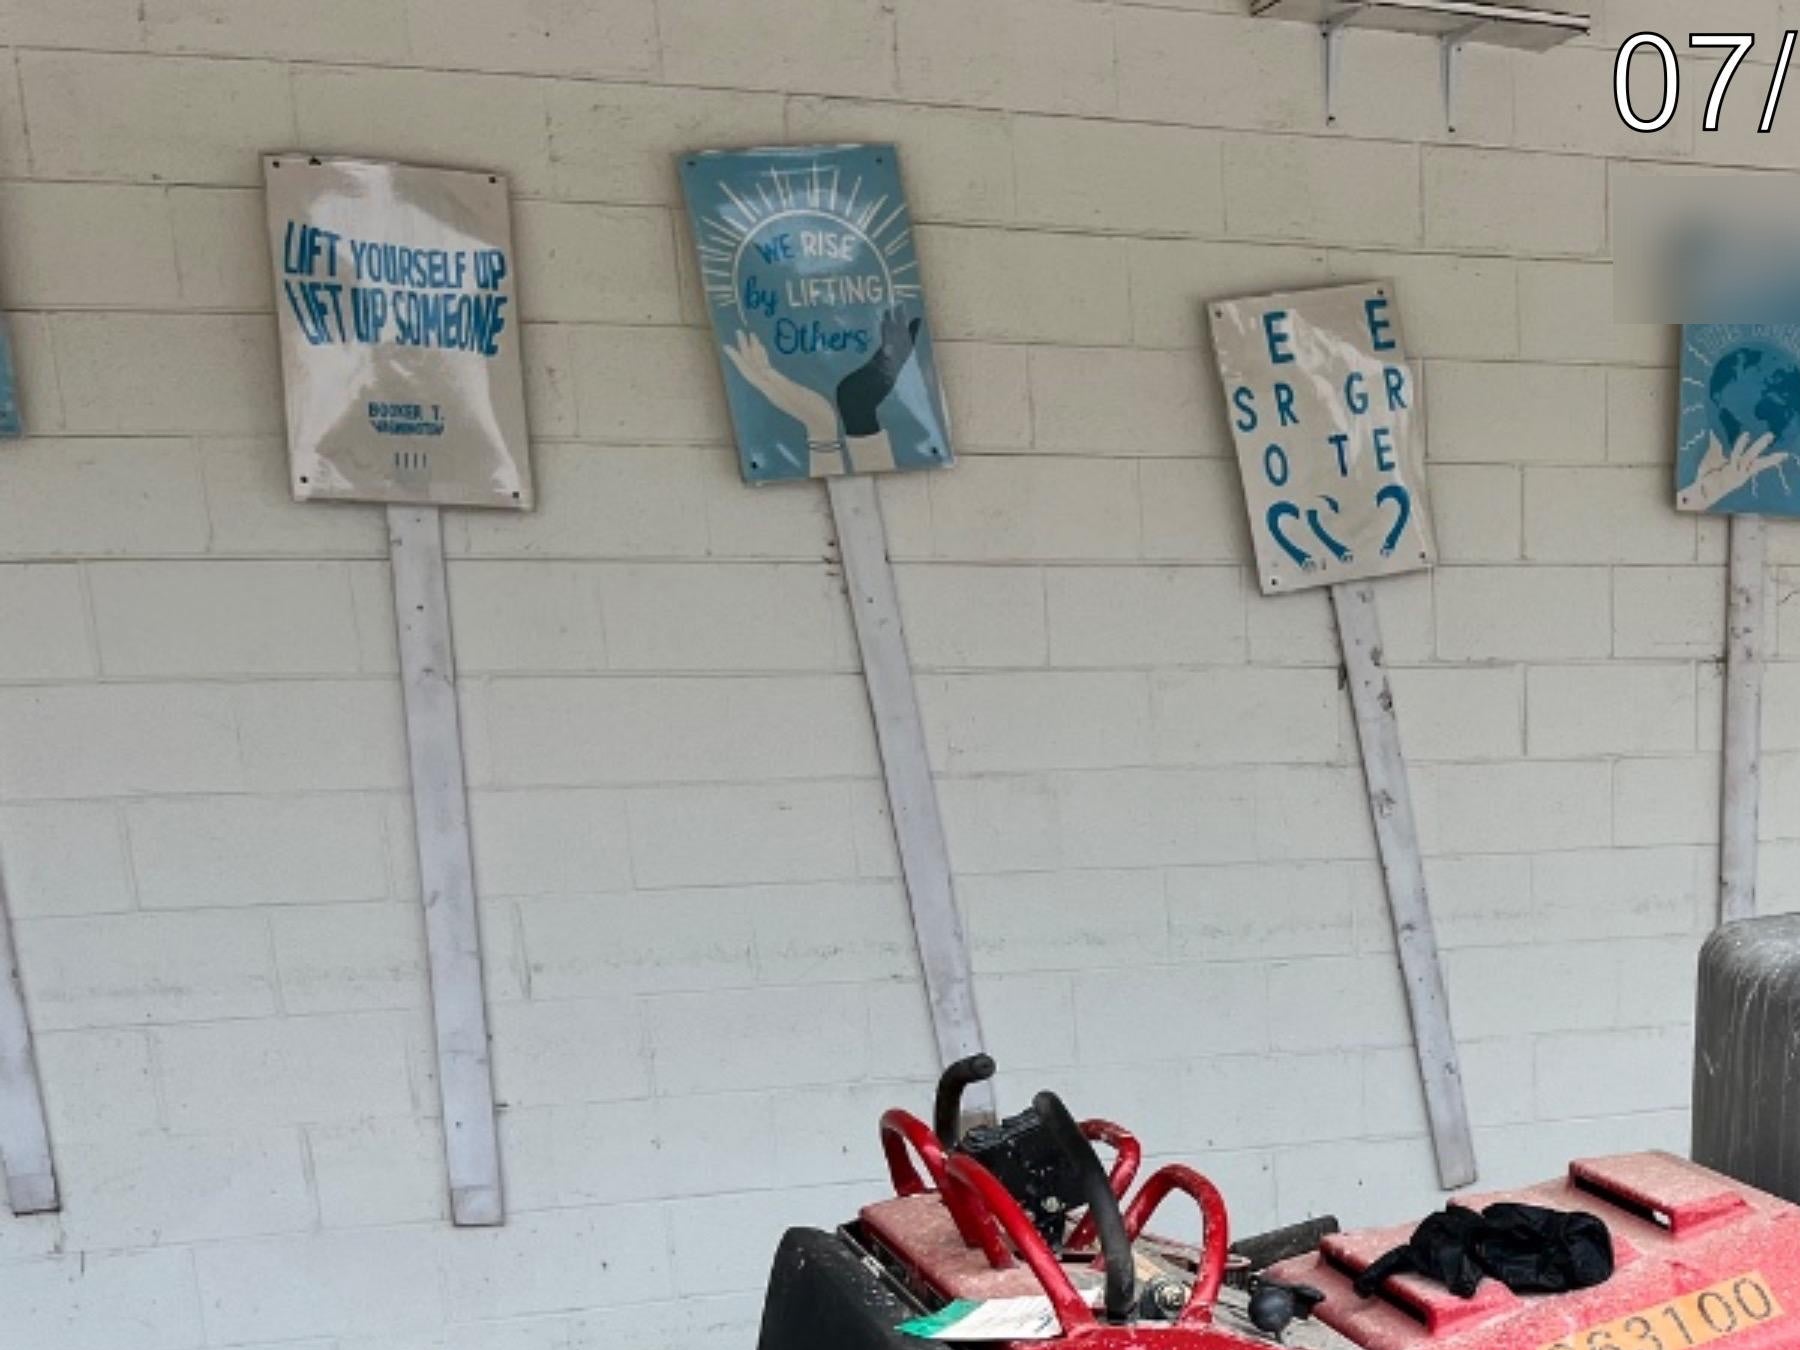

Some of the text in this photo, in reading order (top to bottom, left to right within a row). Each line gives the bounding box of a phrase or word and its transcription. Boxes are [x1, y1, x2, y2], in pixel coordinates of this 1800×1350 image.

[284, 221, 508, 291] LIFT YOURSELF UP
[754, 231, 857, 265] WE RISE
[743, 275, 883, 316] by LIFTING
[284, 279, 508, 356] LIFT UP SOMEONE
[773, 318, 873, 354] Others
